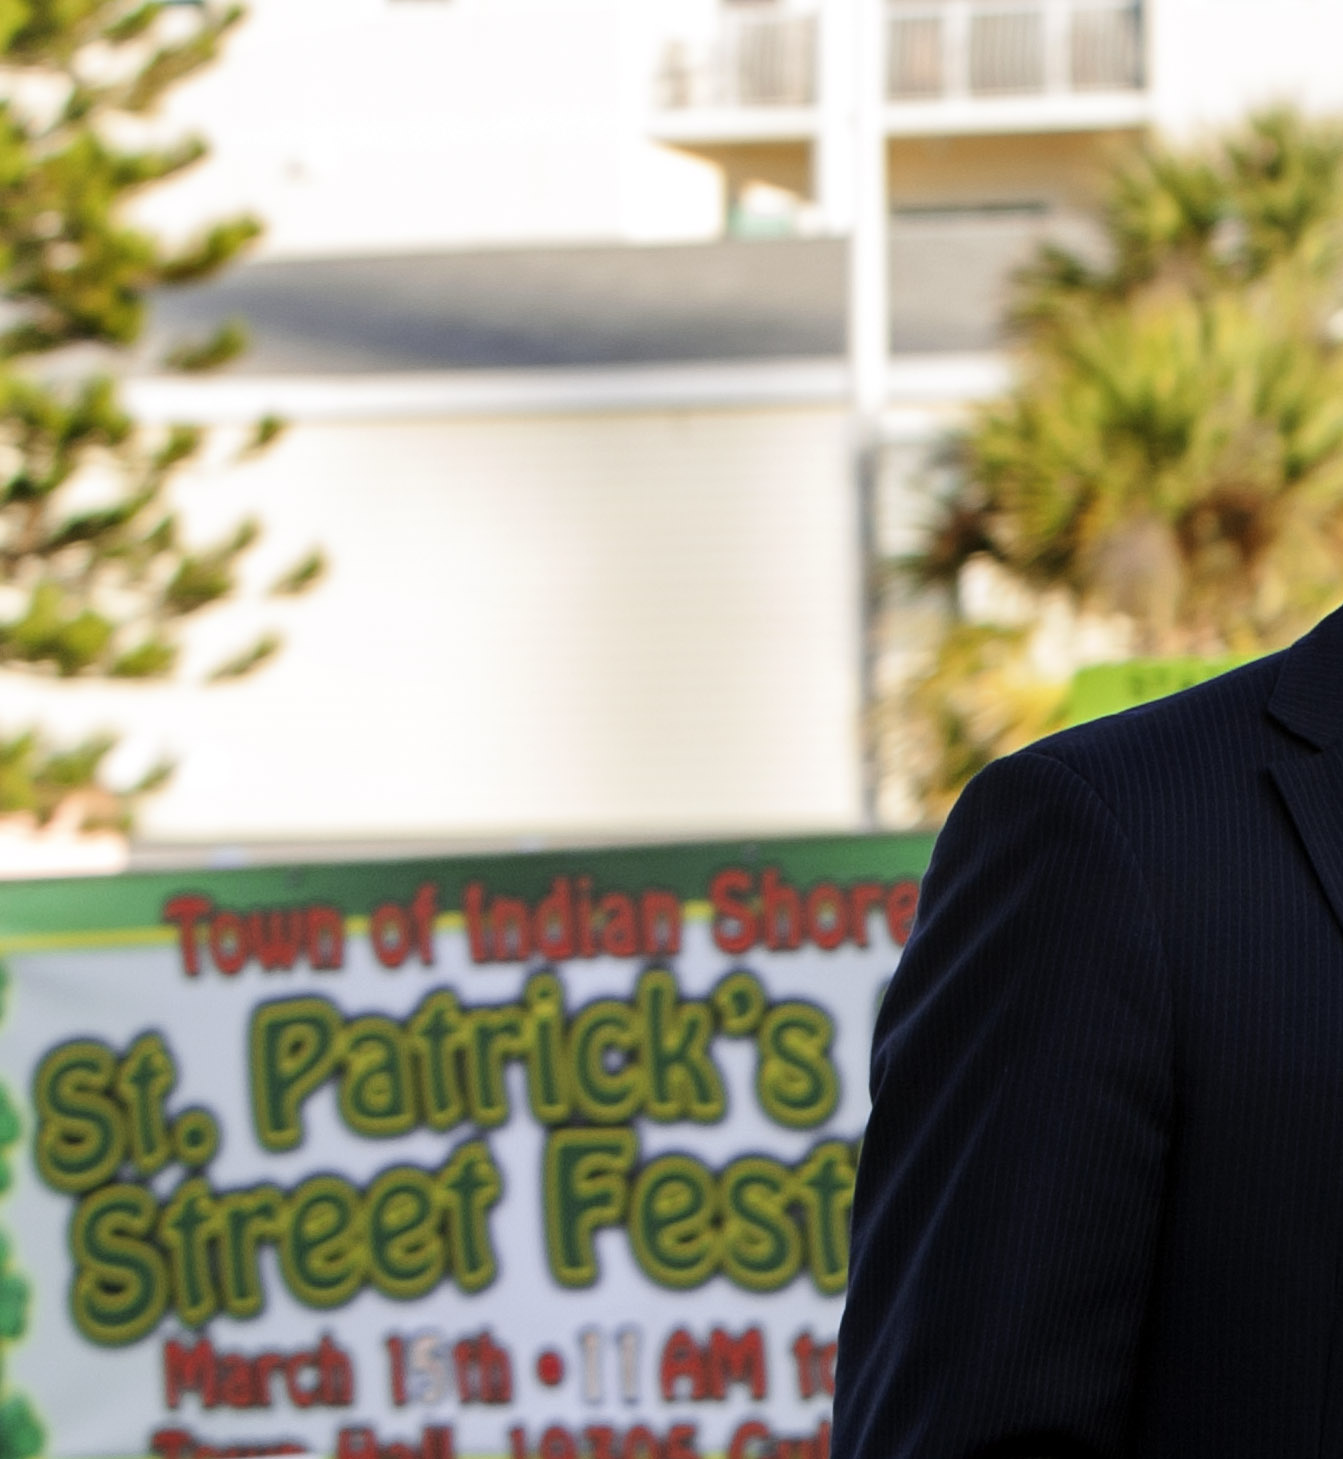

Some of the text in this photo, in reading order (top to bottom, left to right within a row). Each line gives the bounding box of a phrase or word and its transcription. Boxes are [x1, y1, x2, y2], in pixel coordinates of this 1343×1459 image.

[163, 893, 344, 977] Town
[370, 881, 438, 968] of
[464, 872, 681, 965] Indian
[33, 967, 840, 1195] St. Patrick's
[70, 1137, 502, 1345] Street
[163, 1332, 353, 1408] March
[660, 1323, 766, 1403] AM
